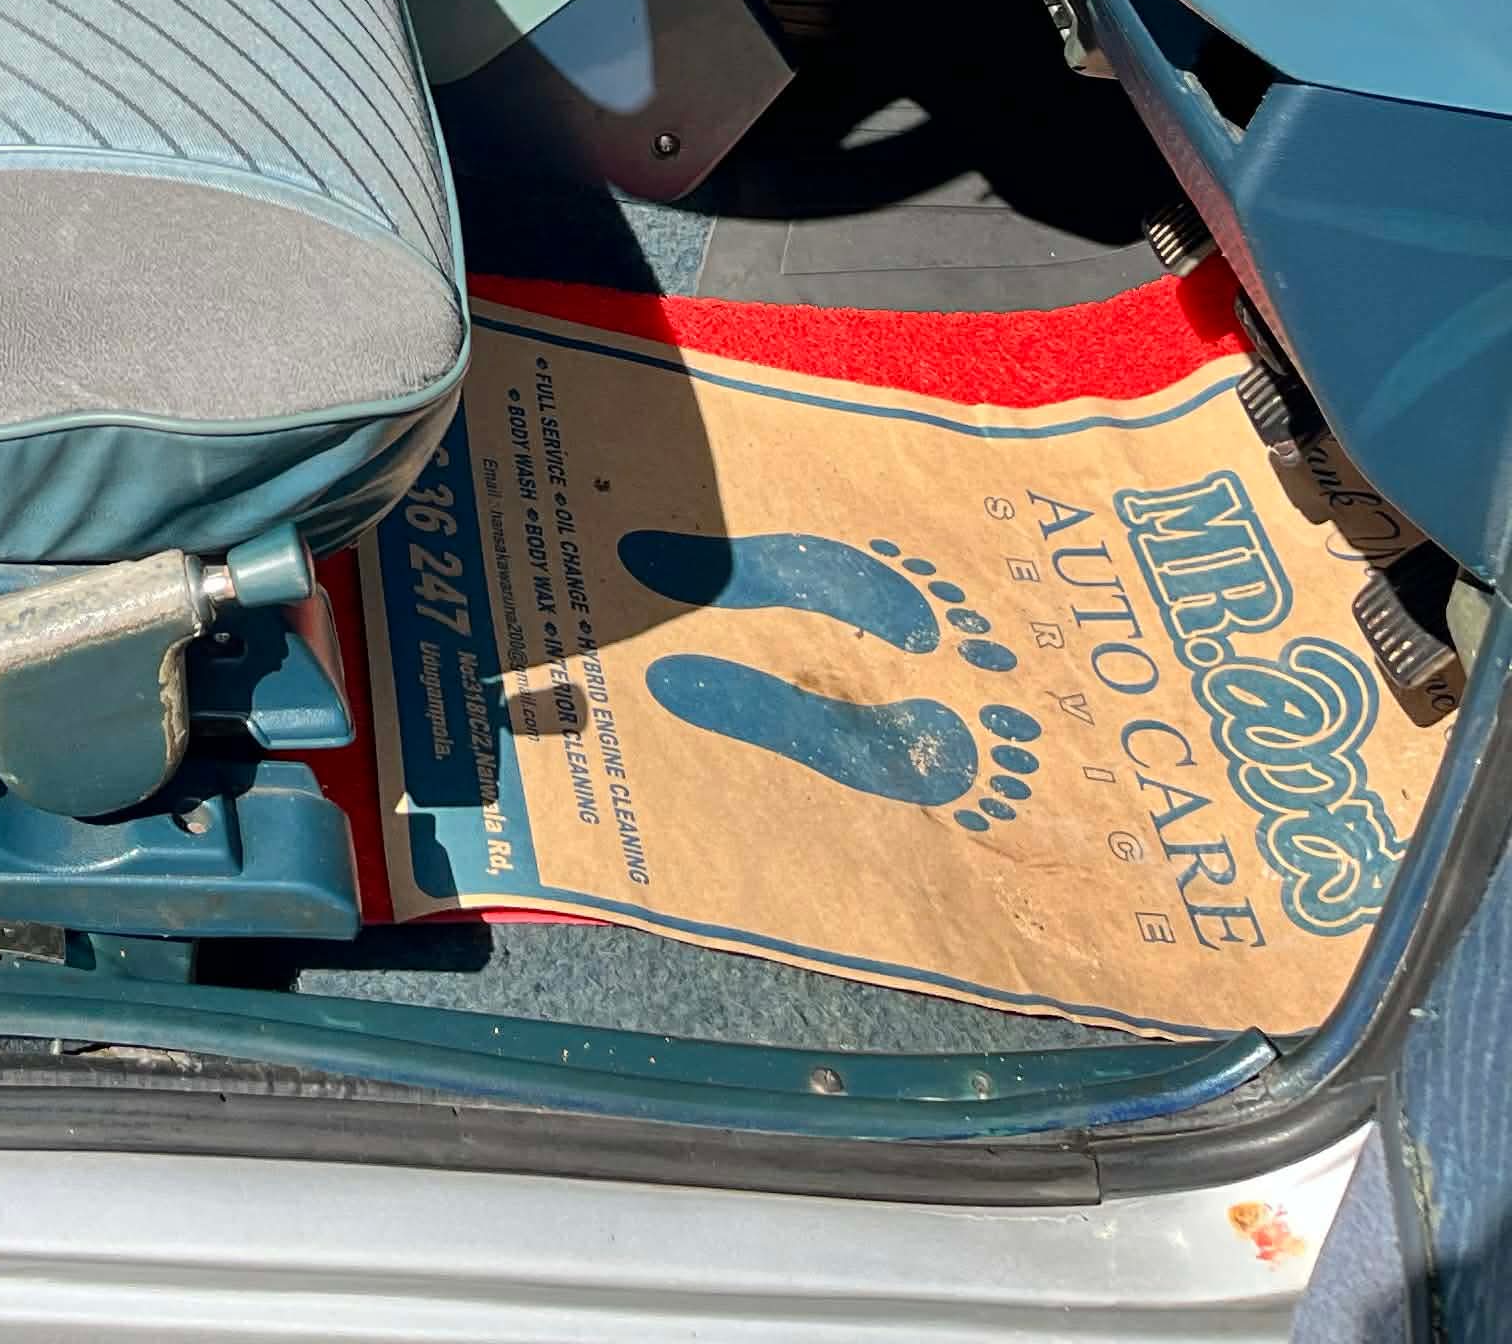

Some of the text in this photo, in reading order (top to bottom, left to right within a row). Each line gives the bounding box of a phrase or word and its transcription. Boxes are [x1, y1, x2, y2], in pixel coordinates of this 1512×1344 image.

[405, 484, 472, 638] 36 247
[507, 405, 600, 825] BODY WASH BODY WAX INTERIOR CLEANING
[536, 373, 649, 885] FULL SERVICE OIL CHANGE HYBRID ENGINE CLEANING
[983, 495, 1176, 945] SERVICE
[1026, 489, 1266, 953] AUTO CARE
[486, 839, 514, 876] Rd,
